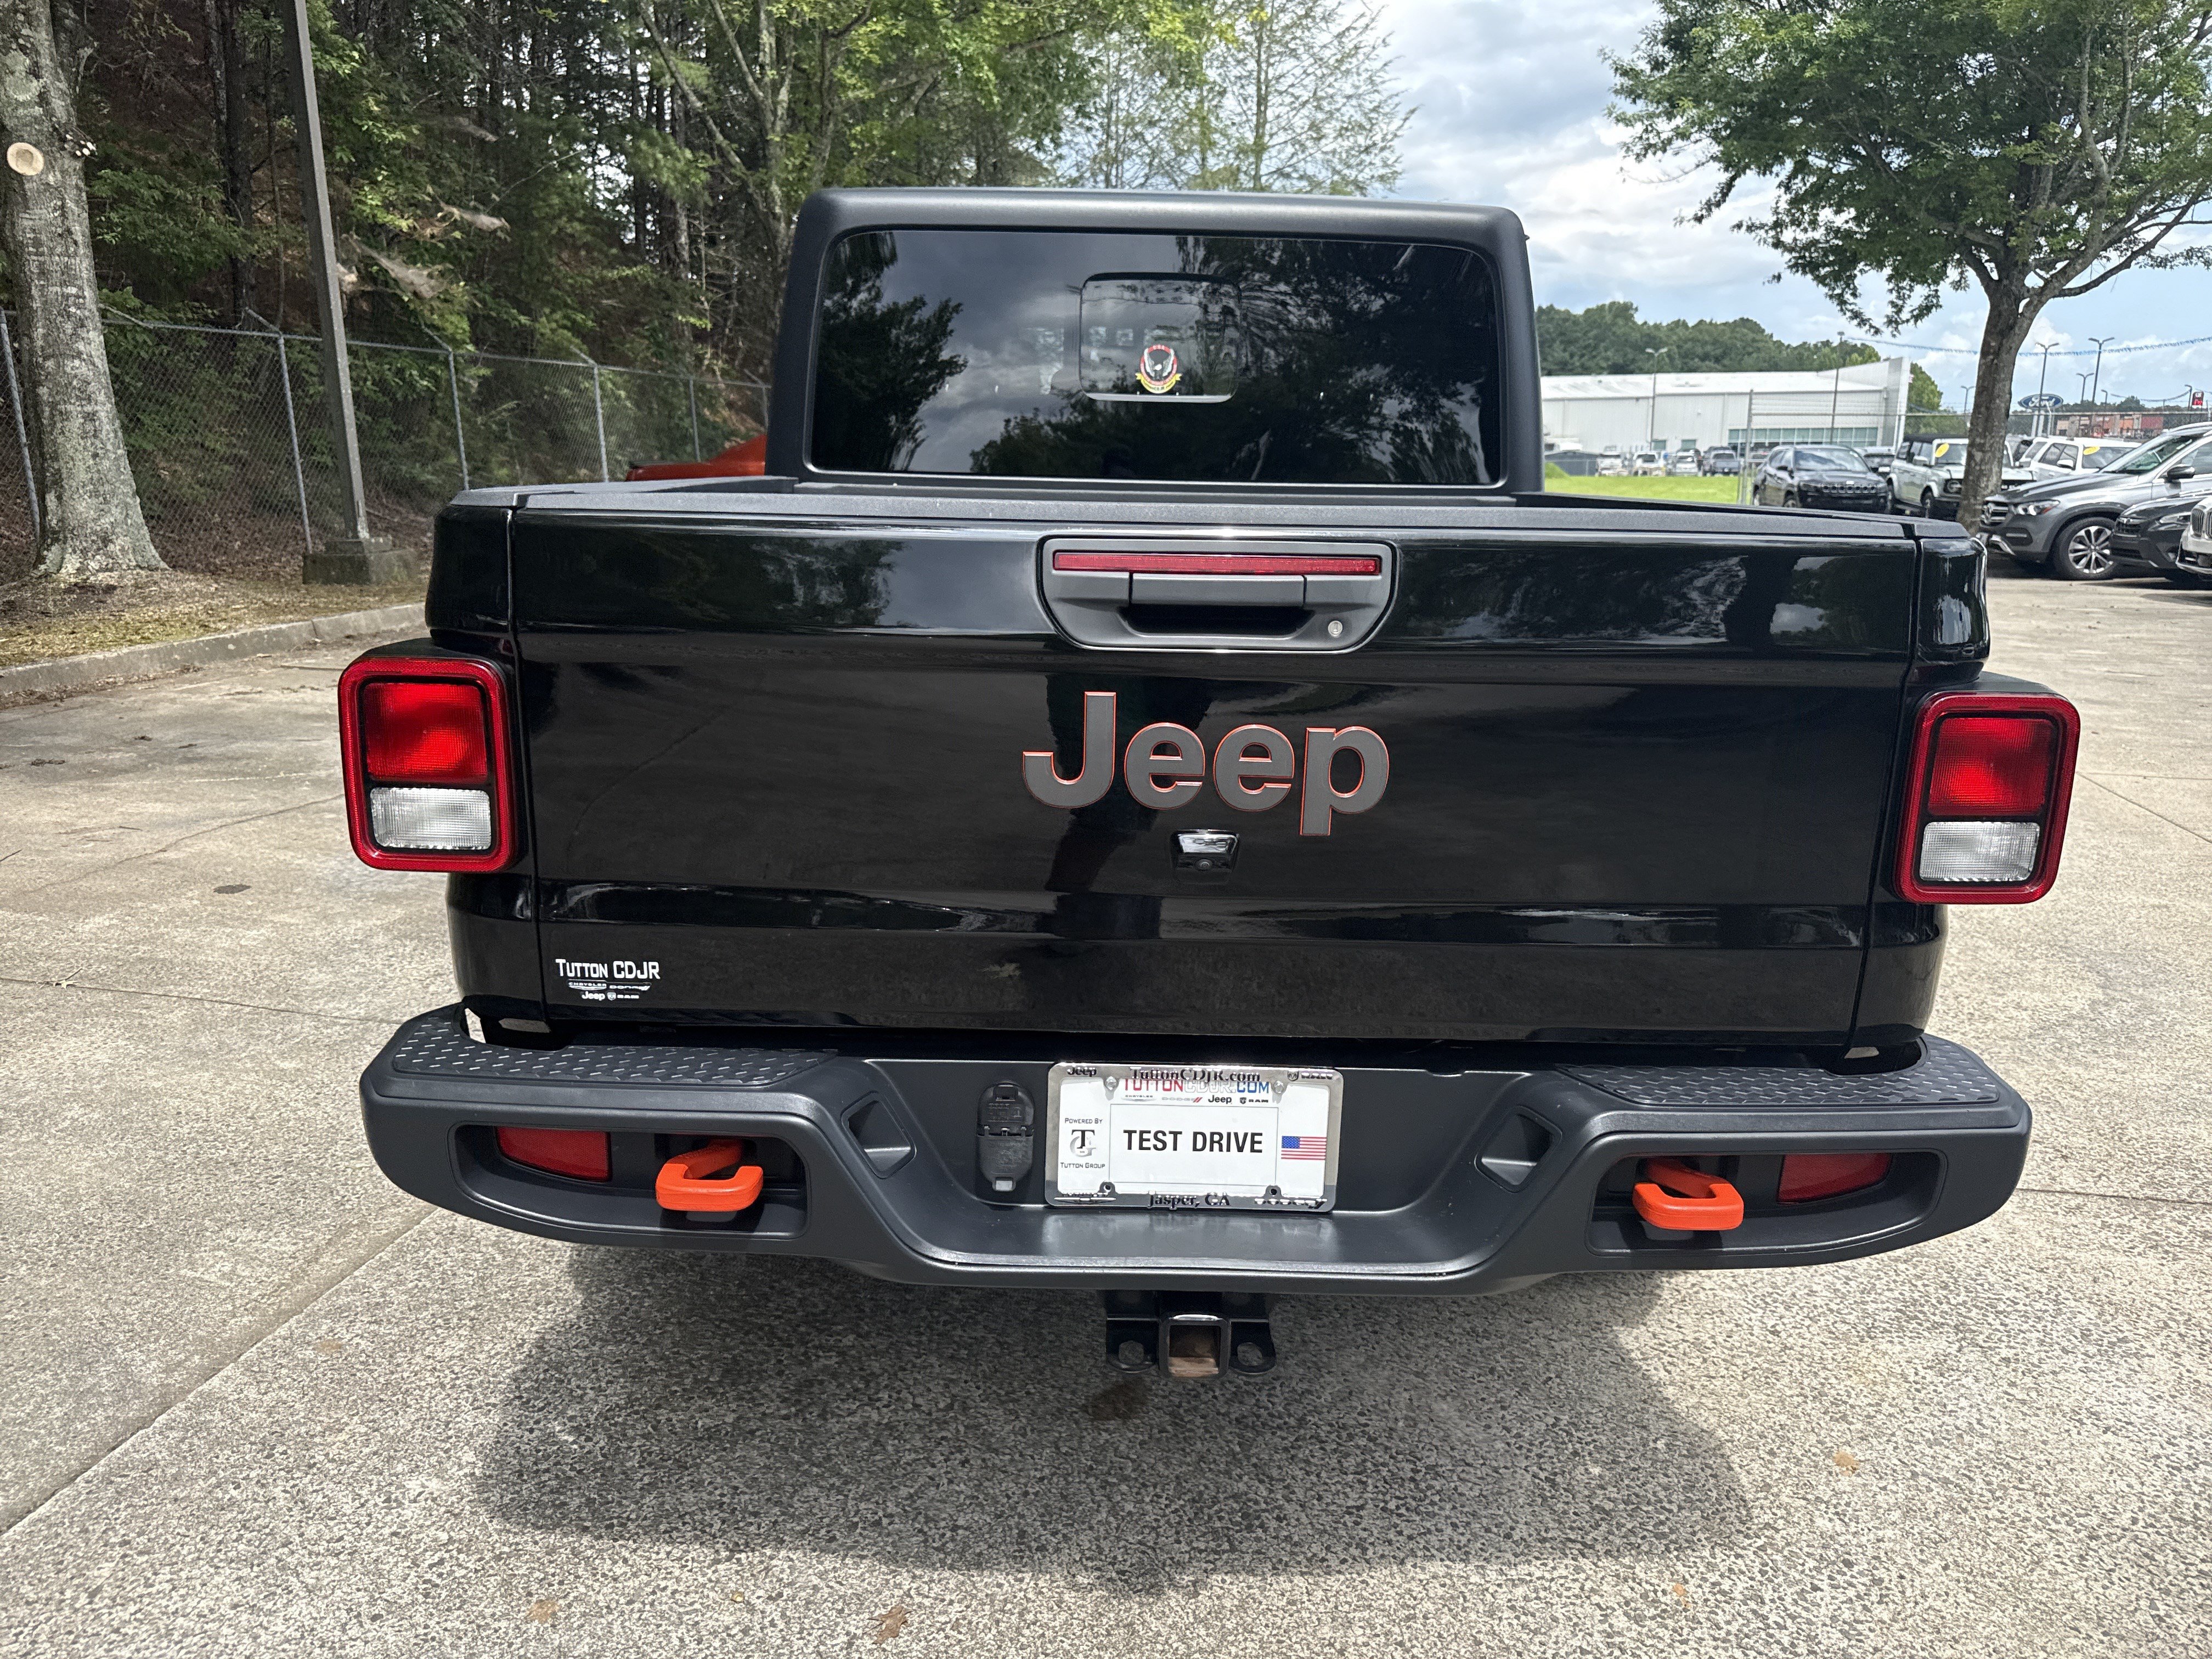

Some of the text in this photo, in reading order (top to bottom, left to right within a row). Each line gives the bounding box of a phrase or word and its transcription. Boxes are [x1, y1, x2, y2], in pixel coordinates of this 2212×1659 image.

[1022, 691, 1390, 836] Jeep
[613, 961, 661, 979] CDJR
[582, 991, 606, 1001] Jeep
[1067, 1064, 1097, 1077] Jeep
[1130, 1068, 1261, 1084] TuttonCDJR.com
[1208, 1095, 1232, 1104] Jeep
[1123, 1129, 1263, 1153] TEST DRIVE
[1148, 1191, 1200, 1209] Jasper,
